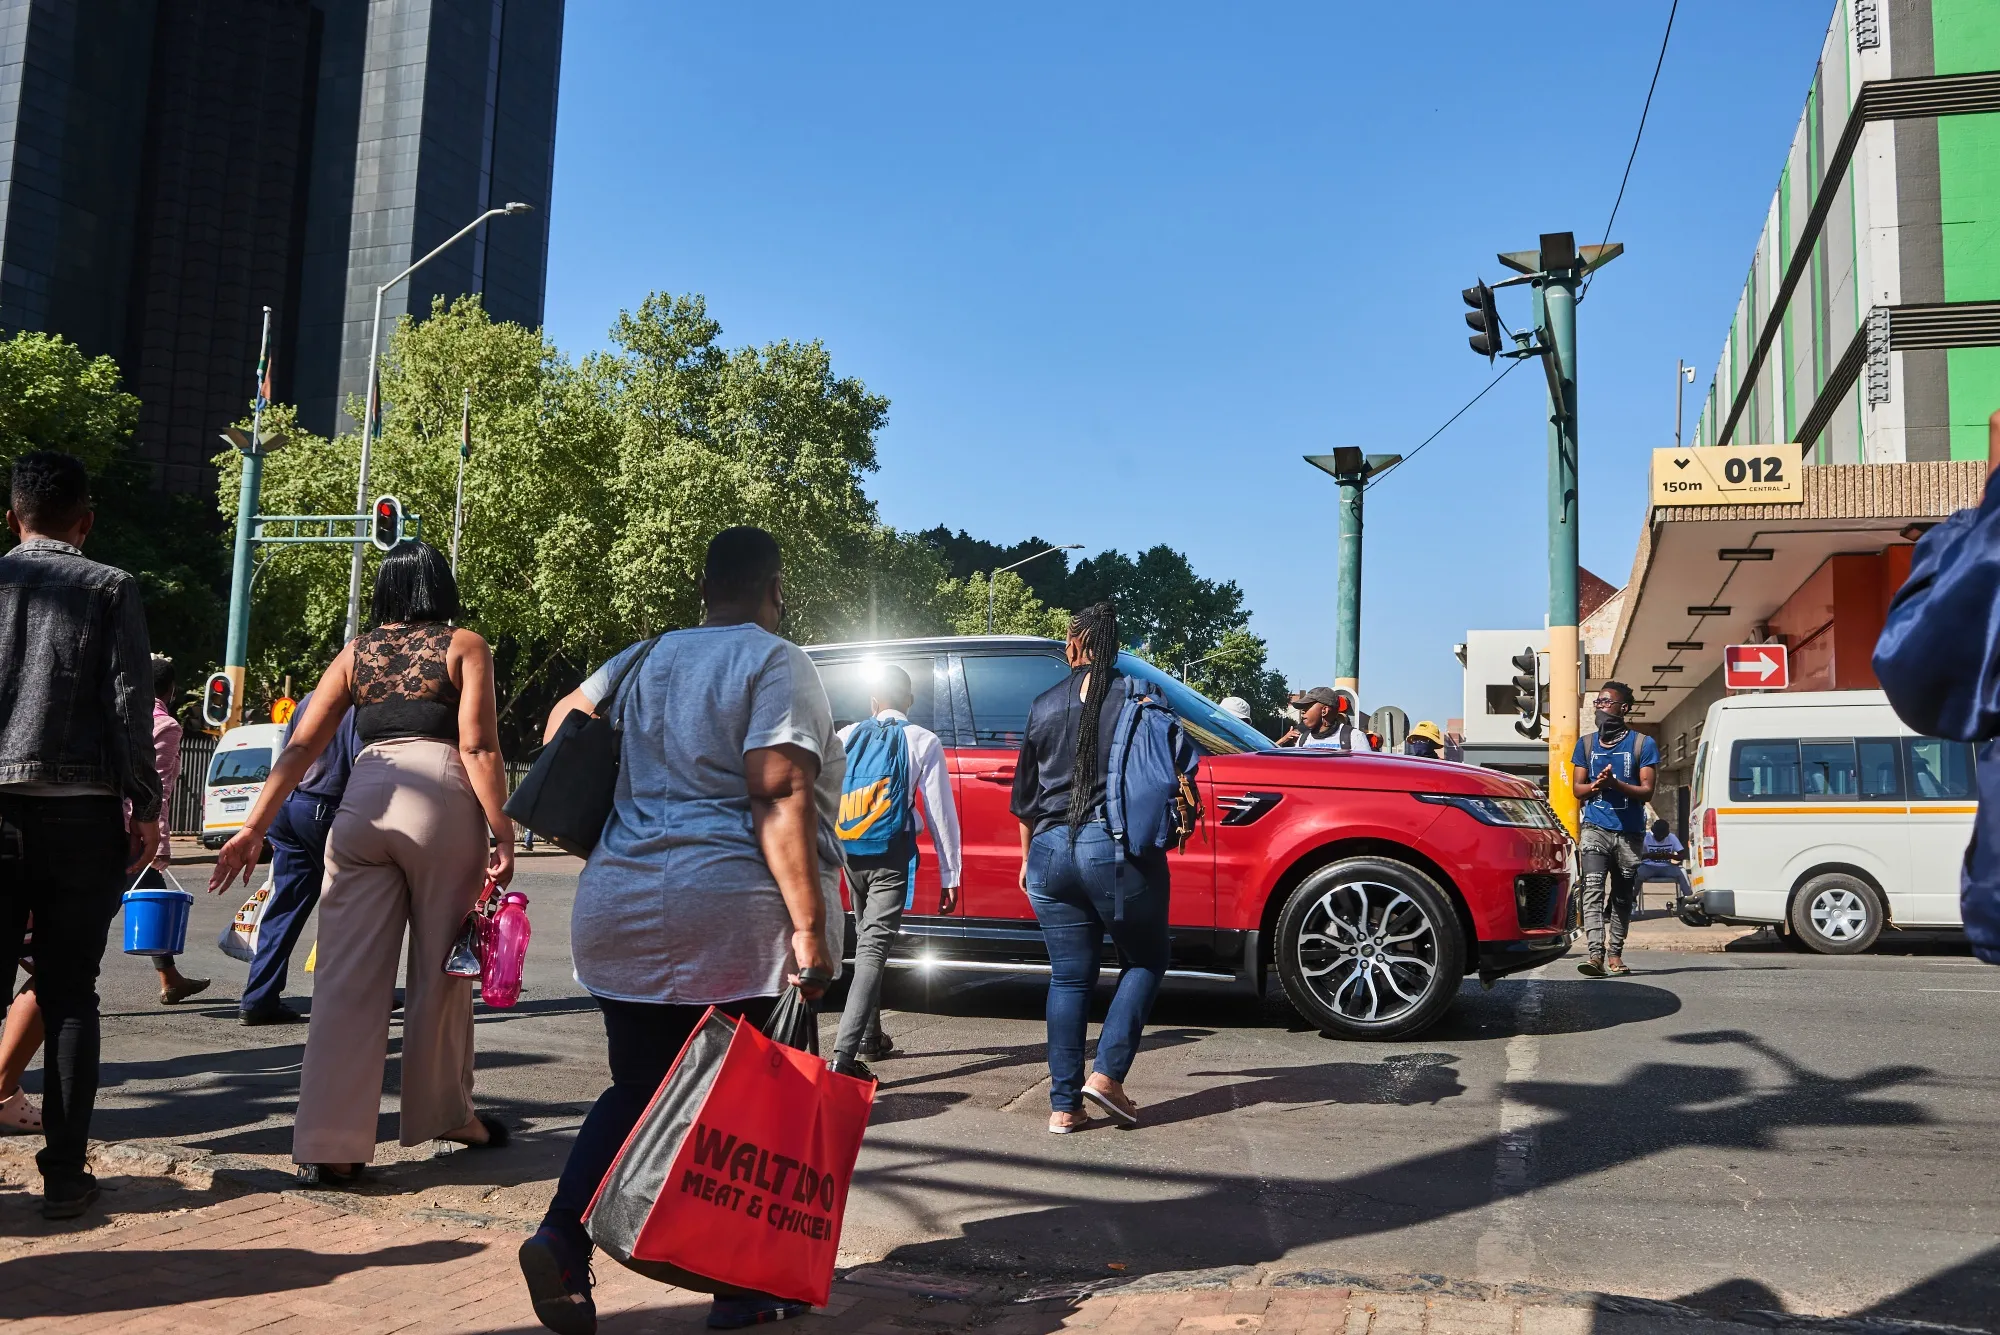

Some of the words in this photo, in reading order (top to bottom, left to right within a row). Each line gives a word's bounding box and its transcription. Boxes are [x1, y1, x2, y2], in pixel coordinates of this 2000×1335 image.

[1662, 481, 1703, 493] 150m
[1724, 456, 1784, 484] 012
[838, 777, 891, 825] NIKE
[680, 1169, 745, 1212] MEAT
[746, 1194, 763, 1219] &
